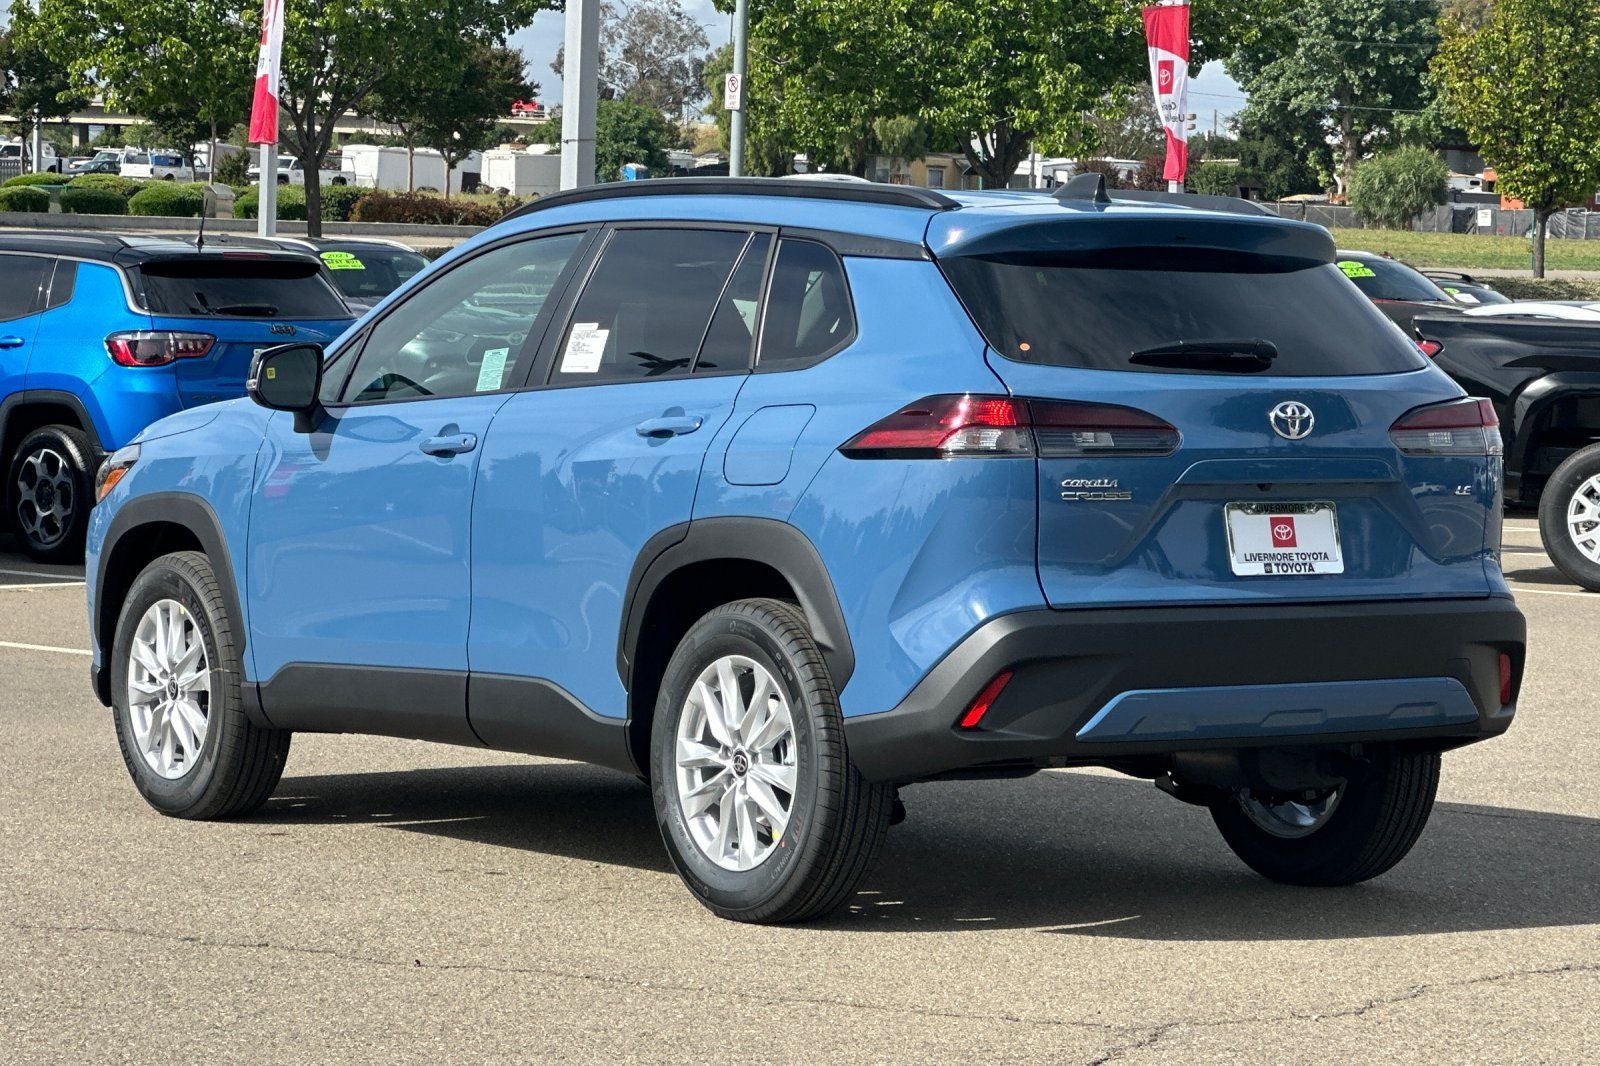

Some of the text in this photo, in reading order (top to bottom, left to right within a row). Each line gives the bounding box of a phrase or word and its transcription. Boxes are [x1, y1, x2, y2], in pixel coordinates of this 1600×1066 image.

[1061, 479, 1118, 488] COROLLA
[1455, 485, 1472, 495] LE
[1061, 491, 1132, 500] CROSS
[1256, 503, 1306, 512] LIVERMORE
[1244, 551, 1330, 562] LIVERMORE TOYOTA
[1274, 562, 1316, 573] TOYOTA
